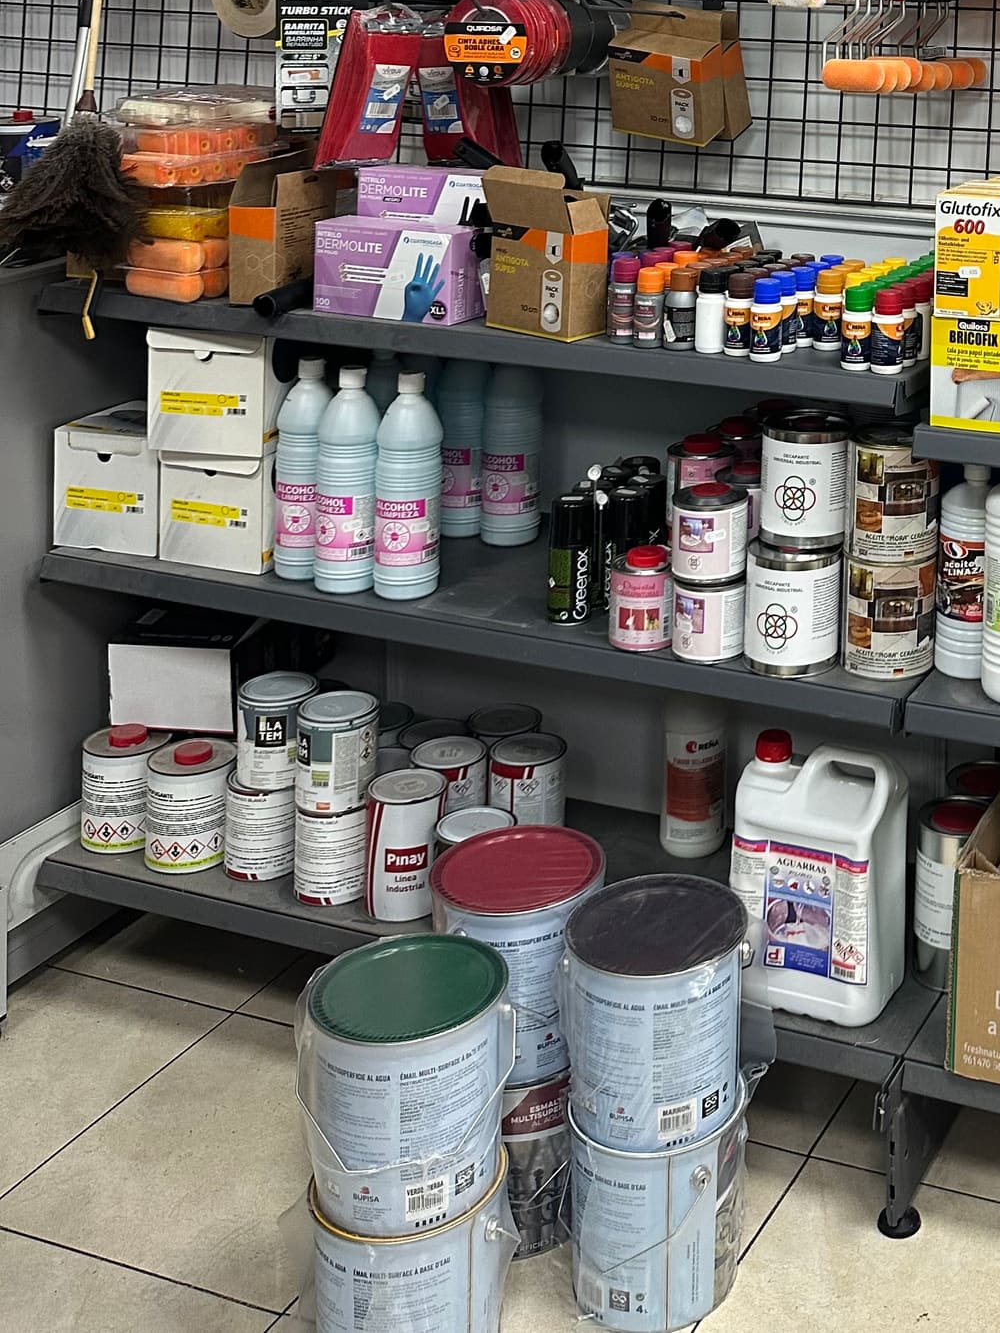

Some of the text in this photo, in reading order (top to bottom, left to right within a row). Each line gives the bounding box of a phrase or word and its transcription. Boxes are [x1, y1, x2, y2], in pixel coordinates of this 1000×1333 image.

[280, 6, 353, 15] TURBO STICK
[284, 22, 325, 31] BARRITA
[615, 73, 655, 86] ANTIGOTA
[615, 80, 641, 90] SUPER
[359, 183, 428, 198] DERMOLITE
[953, 218, 986, 235] 600
[317, 231, 342, 239] NITRILO
[317, 237, 383, 254] DERMOLITE
[496, 255, 529, 267] ANTIGOTA
[495, 263, 516, 274] SUPER
[545, 285, 560, 293] PACK
[315, 297, 330, 306] 100
[520, 304, 530, 312] 10
[959, 321, 988, 332] Quilosa
[949, 329, 999, 347] BRICOFIX
[957, 349, 968, 357] para
[968, 349, 983, 357] papel
[376, 500, 420, 512] ALCOHOL
[947, 568, 985, 576] LINAZA
[572, 547, 589, 620] Greenox
[258, 731, 283, 741] TEM
[386, 851, 426, 867] Pinay
[775, 856, 828, 874] AGUARRAS
[385, 880, 426, 893] Industrial
[987, 1020, 997, 1035] a
[662, 1103, 691, 1117] MARRON
[353, 1193, 380, 1203] BUPISA
[419, 1264, 434, 1275] BASE
